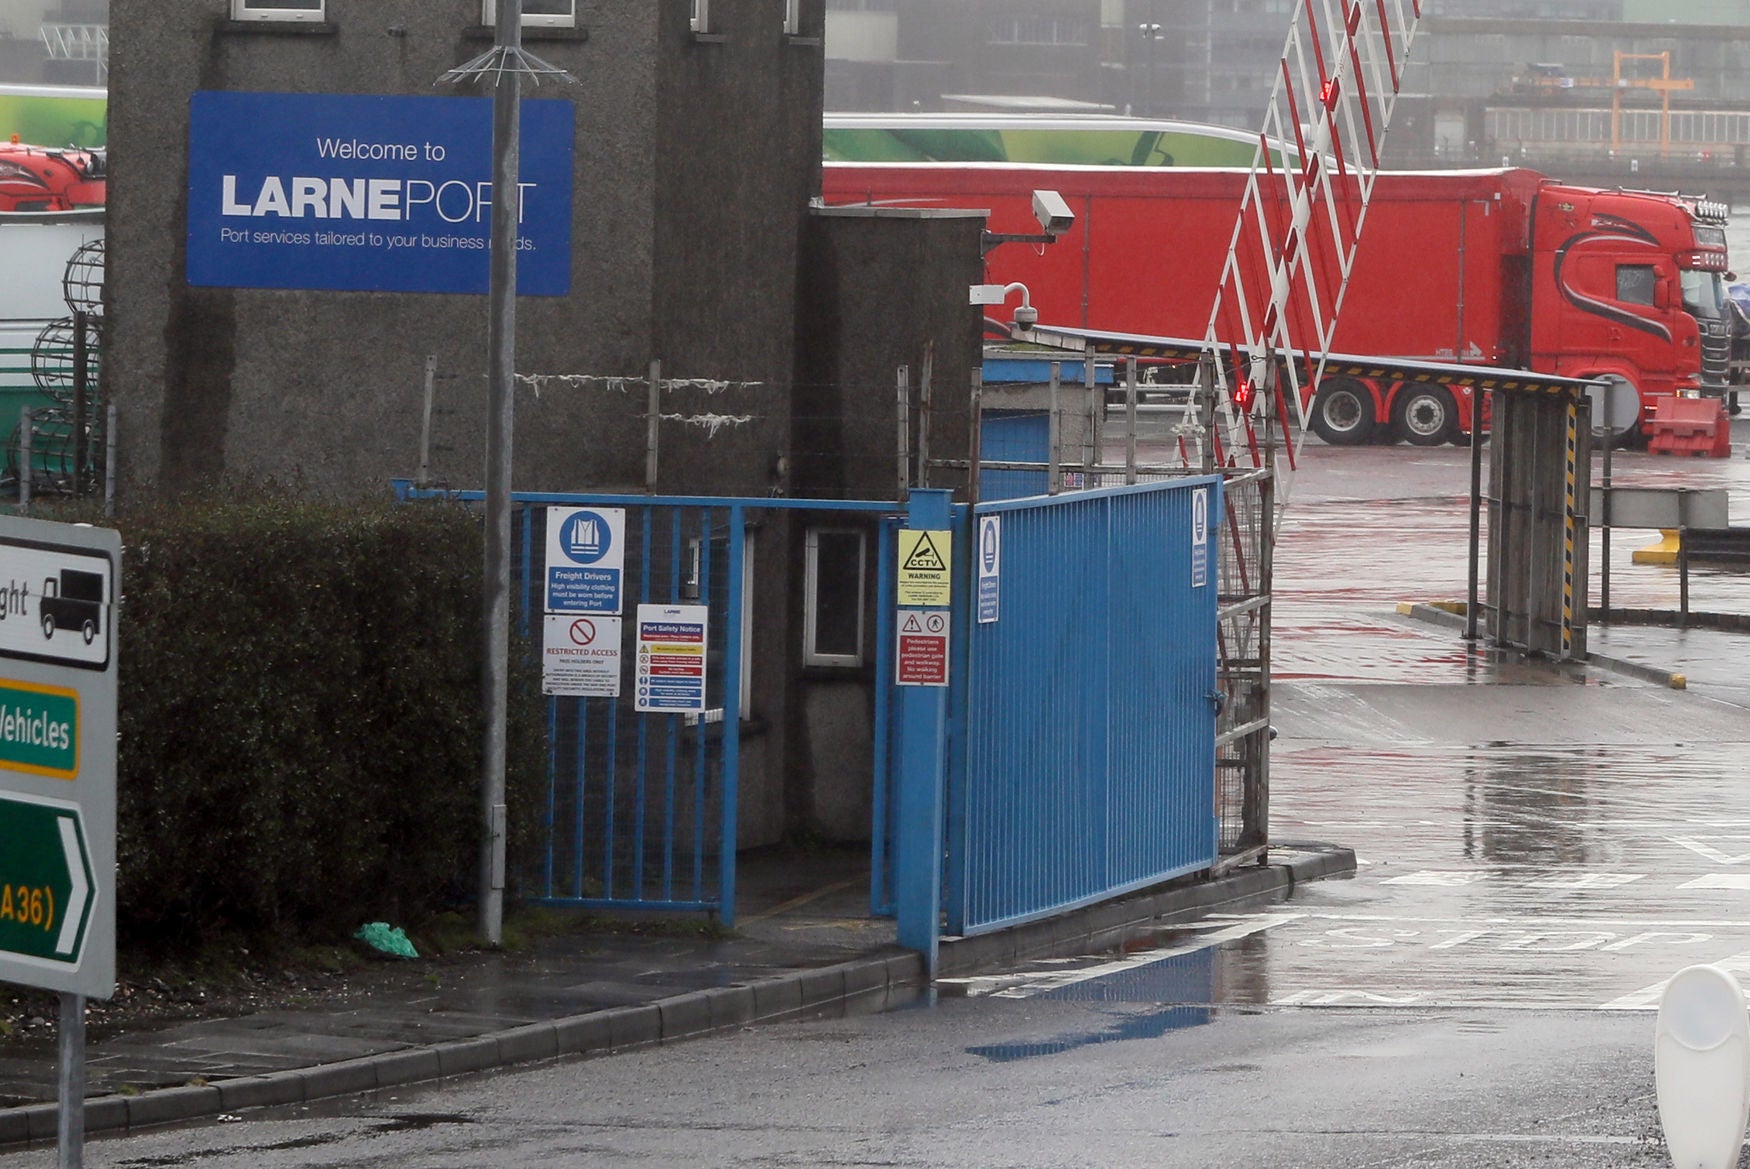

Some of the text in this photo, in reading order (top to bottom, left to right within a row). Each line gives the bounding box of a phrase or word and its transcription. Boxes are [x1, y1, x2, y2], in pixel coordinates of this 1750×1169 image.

[317, 138, 445, 160] Welcome to
[221, 228, 250, 243] Port
[253, 231, 310, 245] services
[315, 231, 365, 246] tailored
[370, 233, 382, 246] to
[387, 237, 417, 250] your
[422, 235, 484, 249] business
[911, 559, 938, 567] CCTV
[555, 571, 612, 581] Freight Drivers
[591, 584, 615, 592] clothing
[658, 625, 679, 633] Safety
[591, 648, 618, 657] ACCESS
[1297, 928, 1713, 951] STOP
